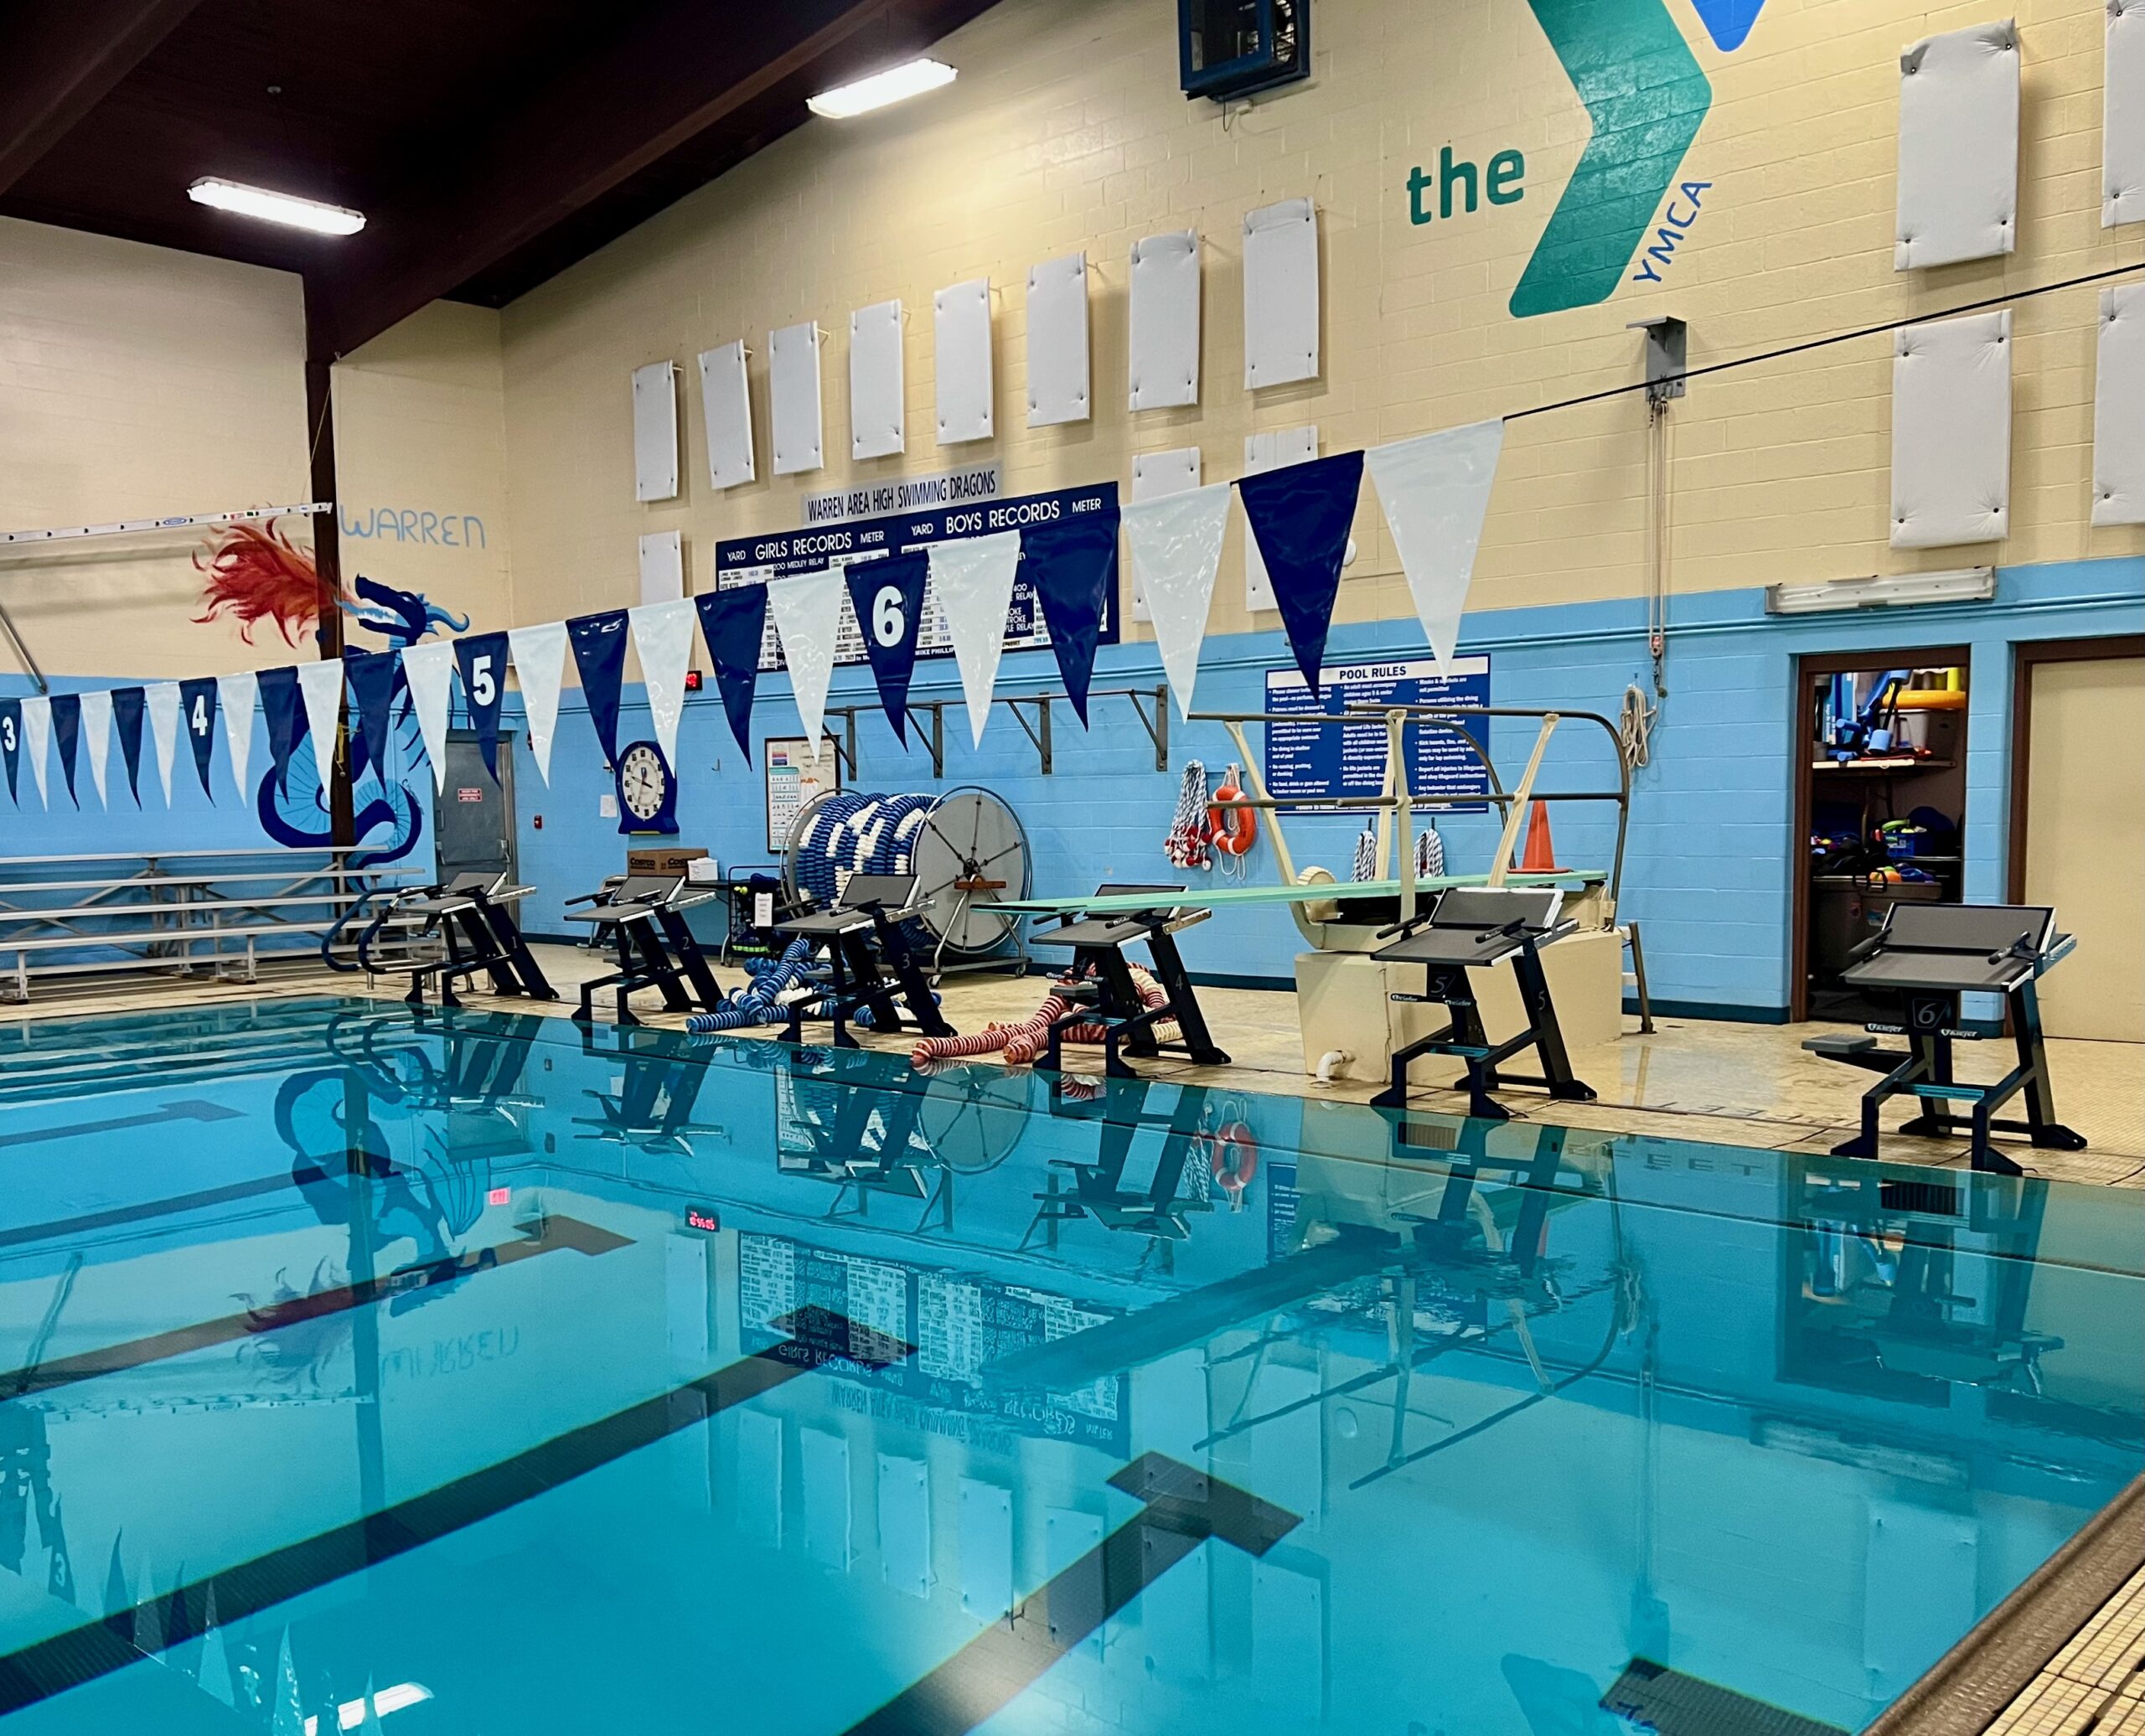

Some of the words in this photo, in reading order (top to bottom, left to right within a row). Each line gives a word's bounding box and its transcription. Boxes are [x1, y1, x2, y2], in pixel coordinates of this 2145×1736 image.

[1406, 146, 1525, 225] the
[1632, 182, 1713, 283] YMCA
[808, 498, 845, 522] WARREN
[847, 493, 871, 517] AREA
[872, 488, 894, 511] HIGH
[897, 481, 947, 509] SWIMMING
[949, 470, 995, 499] DRAGONS
[911, 523, 934, 537] YARD
[946, 512, 983, 535] BOYS
[989, 500, 1061, 528] RECORDS
[1072, 497, 1102, 514] METER
[726, 550, 746, 561] YARD
[755, 540, 788, 561] GIRLS
[793, 532, 852, 556] RECORDS
[860, 531, 885, 544] METER
[809, 557, 824, 566] RELAY
[872, 586, 906, 648] 6
[473, 655, 496, 706] 5
[1340, 668, 1368, 679] POOL
[1372, 666, 1407, 678] RULES
[192, 695, 208, 736] 4
[3, 716, 16, 751] 3
[682, 936, 690, 950] 2
[902, 953, 911, 969] 3
[1077, 957, 1088, 973] 4
[1176, 974, 1184, 990] 4
[1430, 976, 1448, 994] 5
[1538, 989, 1546, 1010] 5
[1918, 1002, 1936, 1024] 6
